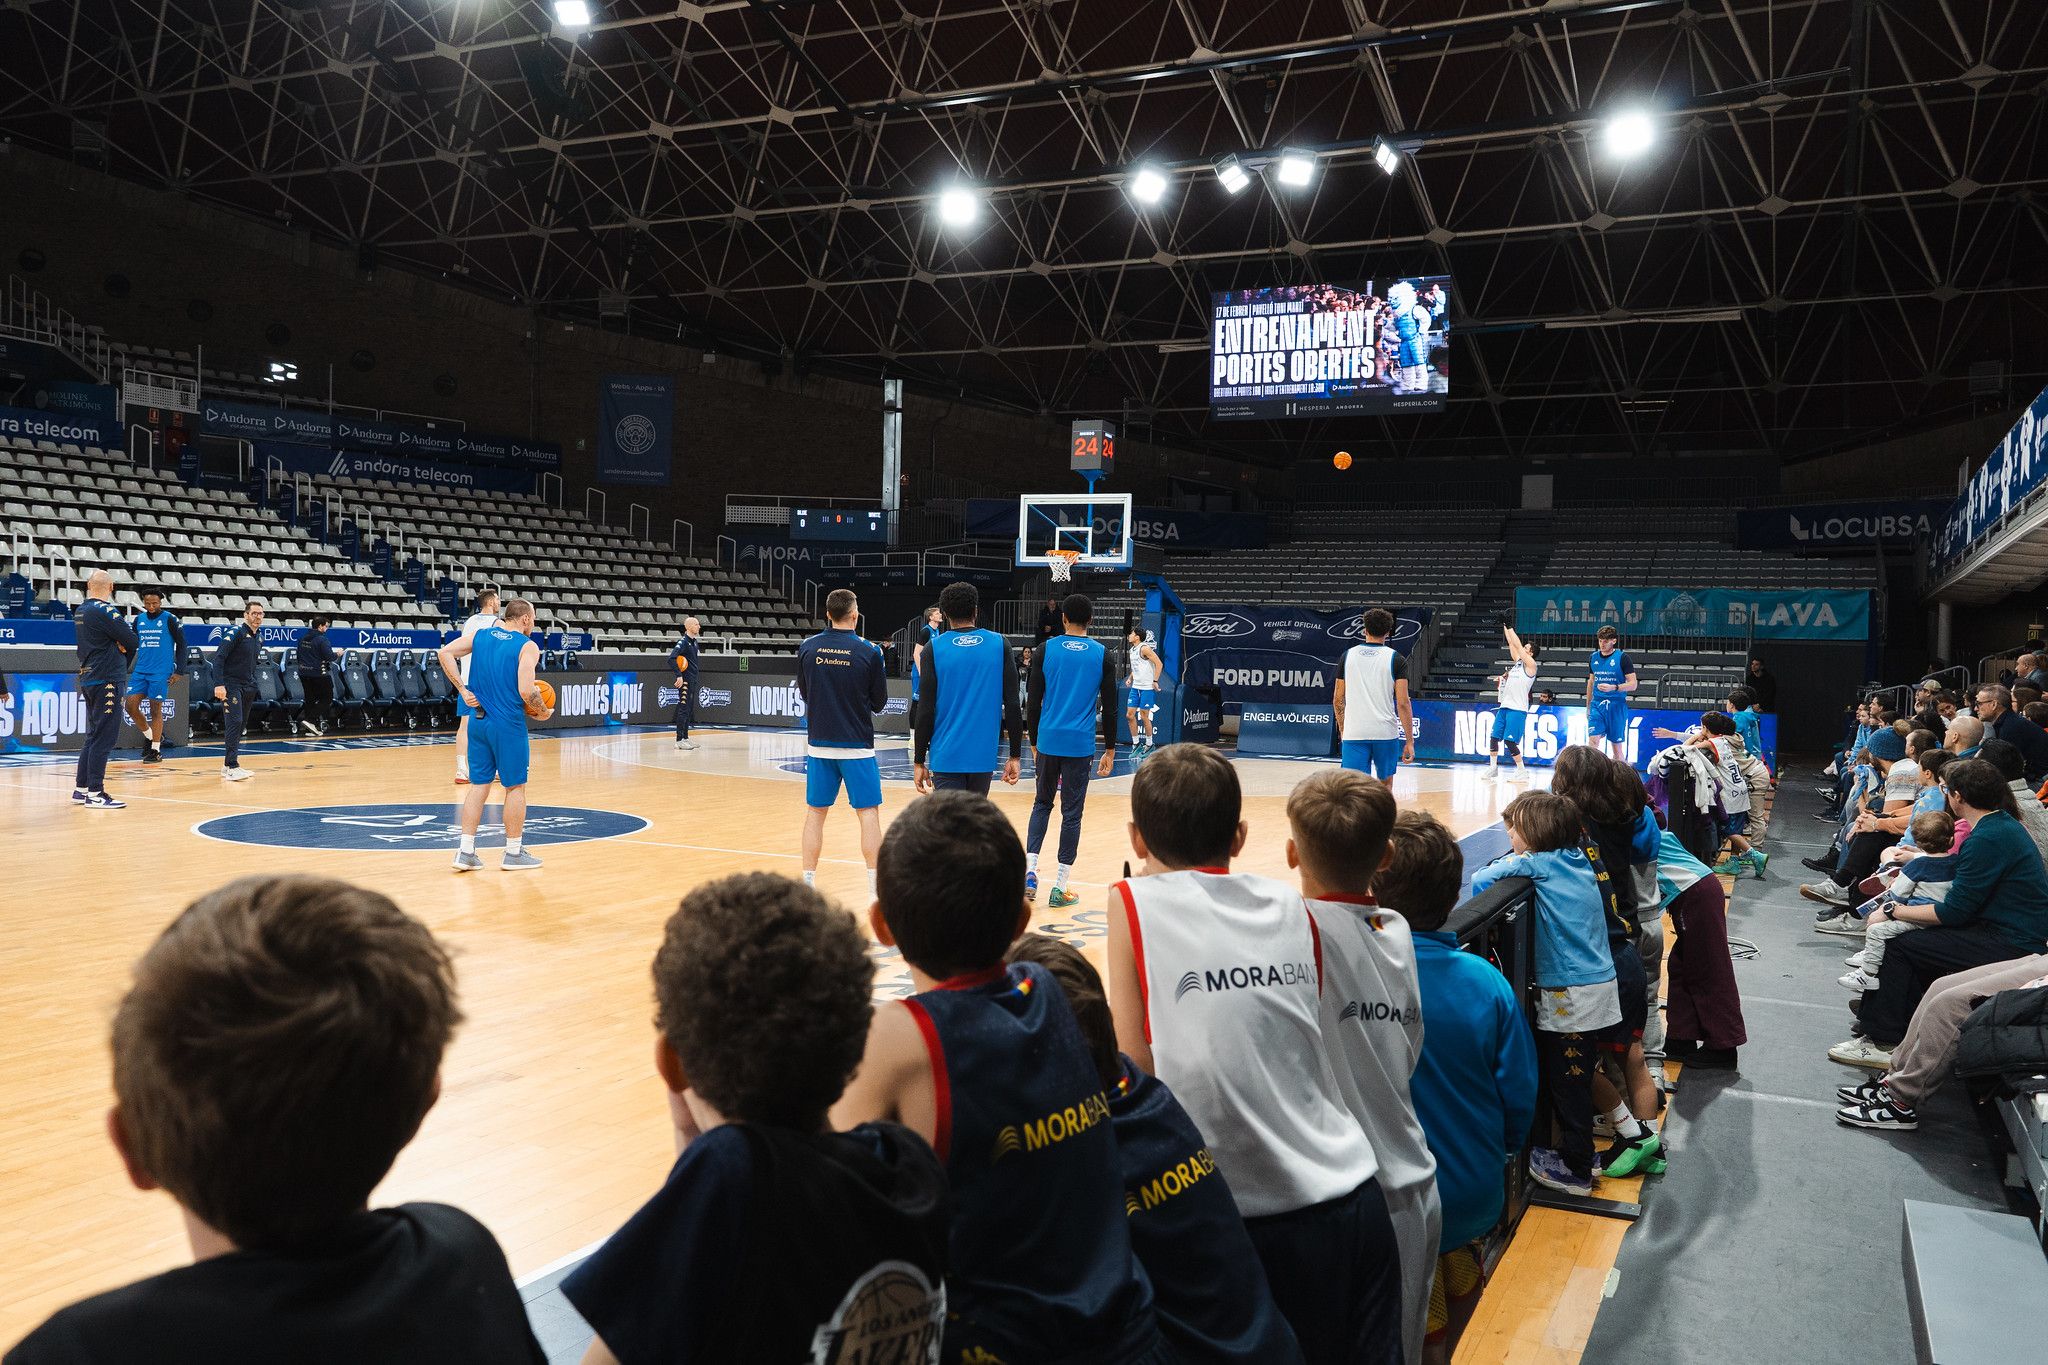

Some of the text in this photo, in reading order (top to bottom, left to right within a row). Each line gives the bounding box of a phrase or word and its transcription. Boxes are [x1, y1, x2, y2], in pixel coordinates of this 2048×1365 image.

[1215, 309, 1376, 354] ENTRENAMENT
[1214, 346, 1375, 385] PORTES OBERTES
[1393, 400, 1438, 408] HESPERIA.COM
[220, 412, 266, 427] Andorra
[288, 420, 332, 434] Andorra
[25, 418, 100, 442] telecom
[352, 427, 392, 441] Andorra
[411, 434, 451, 448] Andorra
[468, 441, 505, 454] Andorra
[1074, 436, 1098, 457] 24
[1102, 438, 1114, 459] 24
[522, 448, 557, 460] Andorra
[354, 459, 473, 485] andorra telecom
[800, 519, 806, 527] 0
[836, 514, 842, 522] 0
[870, 522, 876, 530] 0
[1813, 514, 1931, 540] LOCUBSA
[1540, 600, 1643, 623] ALLAU
[1728, 602, 1839, 627] BLAVA
[1182, 616, 1239, 634] Ford
[1294, 621, 1322, 630] OFICIAL
[264, 628, 298, 641] BANC
[372, 633, 412, 645] Andorra
[824, 657, 851, 666] Andorra
[1213, 668, 1325, 688] FORD PUMA
[561, 677, 643, 720] NOMÉS AQUÍ
[750, 679, 806, 717] NOMÉS
[1189, 709, 1210, 722] Andorra
[1243, 711, 1330, 724] ENGEL&VÖLKERS
[1454, 705, 1559, 760] NOÉS
[1205, 963, 1316, 992] MORABAN
[1024, 1091, 1111, 1152] MORABAN
